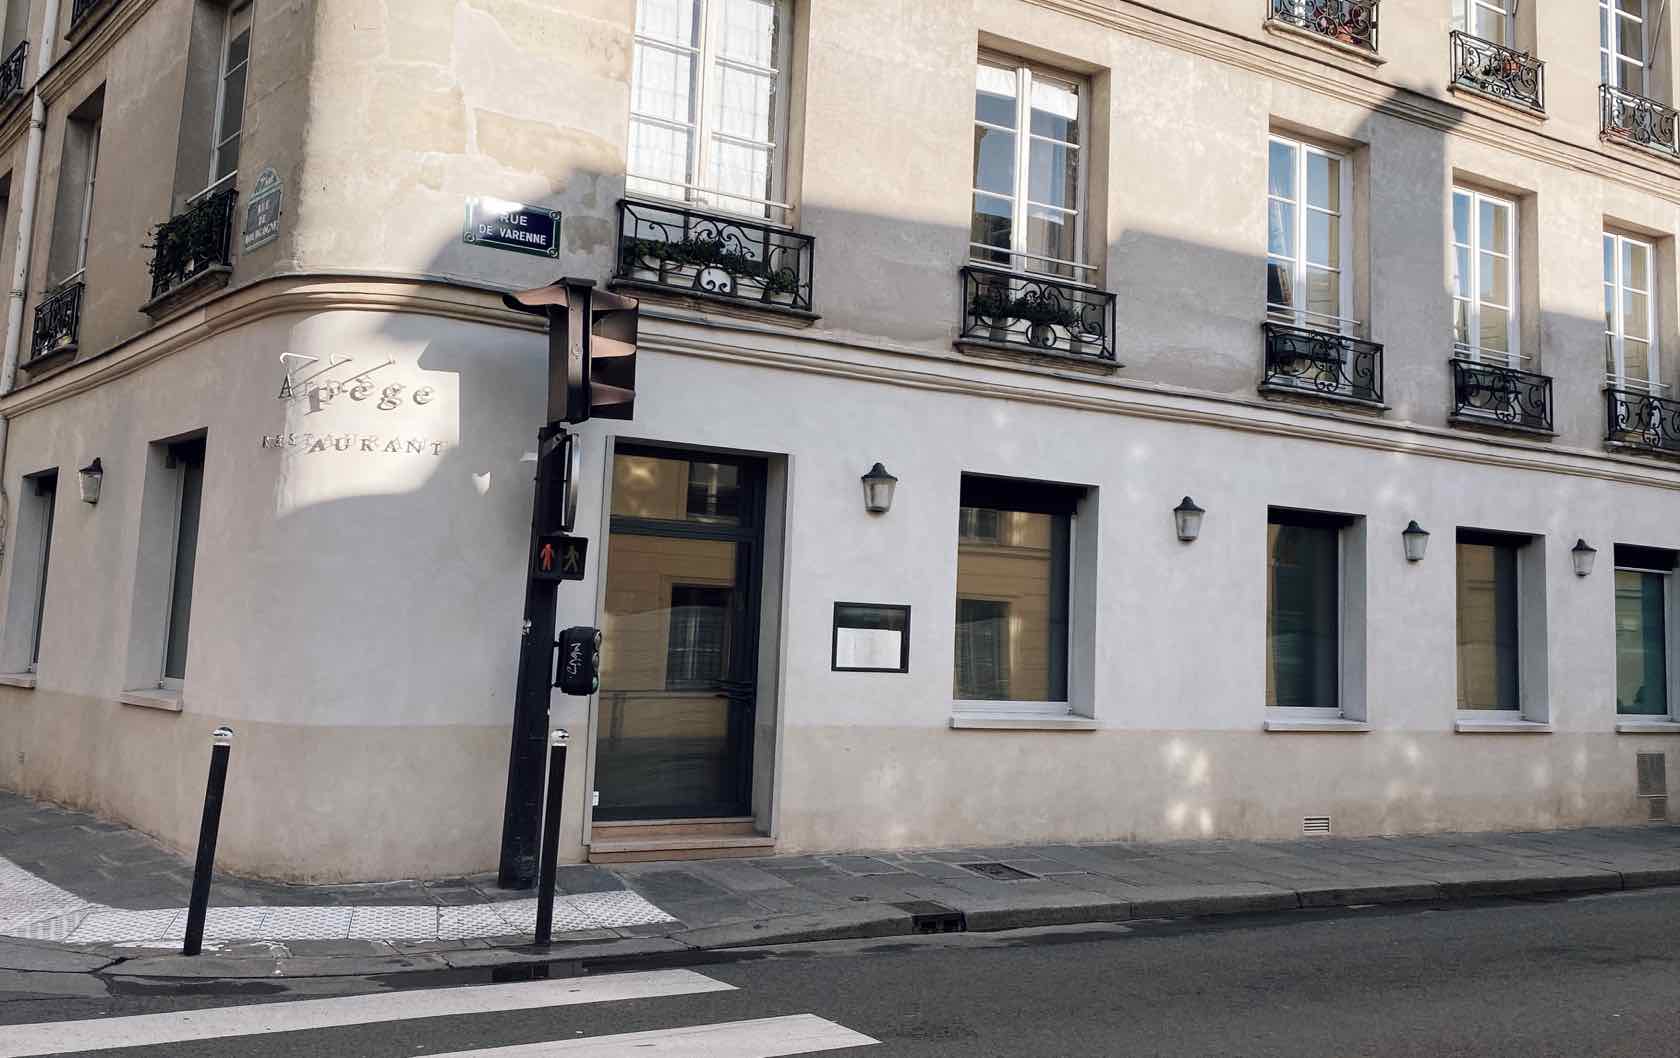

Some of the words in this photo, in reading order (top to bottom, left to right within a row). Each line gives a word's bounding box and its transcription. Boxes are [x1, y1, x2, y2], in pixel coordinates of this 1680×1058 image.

[499, 213, 528, 226] RUE
[478, 223, 493, 235] DE
[499, 227, 547, 246] VARENNE
